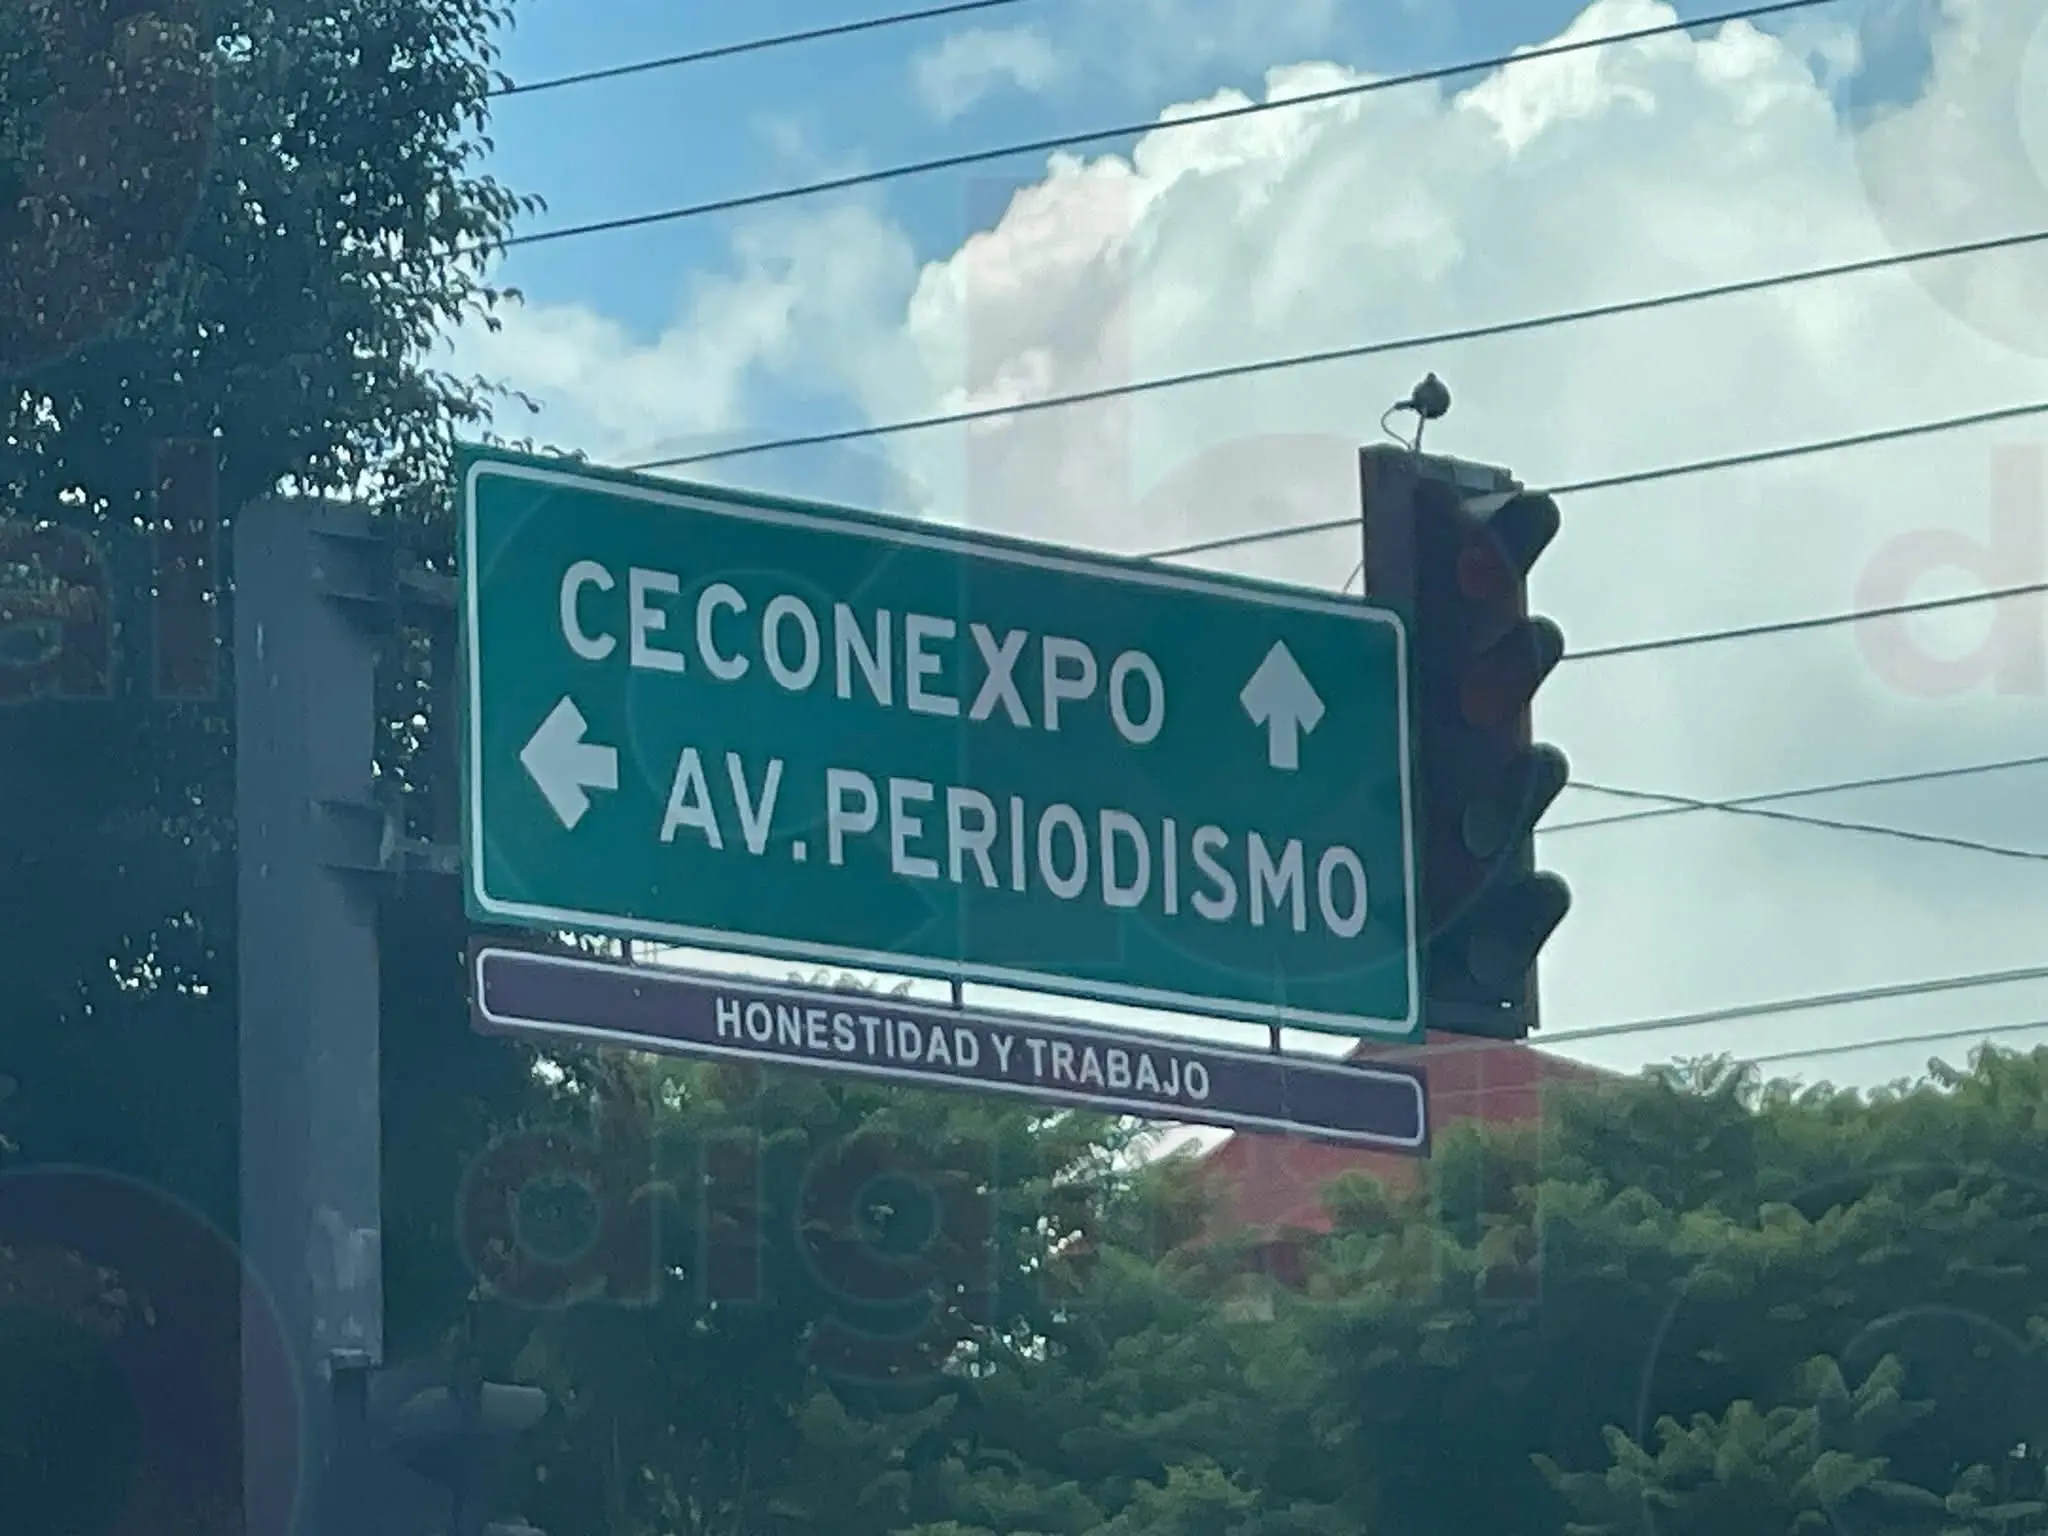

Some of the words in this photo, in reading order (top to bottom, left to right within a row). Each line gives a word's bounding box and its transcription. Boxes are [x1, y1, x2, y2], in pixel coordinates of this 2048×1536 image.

[559, 559, 1165, 744] CECONEXPO
[715, 996, 980, 1068] HONESTIDAD
[991, 1032, 1014, 1074] Y
[1026, 1037, 1210, 1100] TRABAJO
